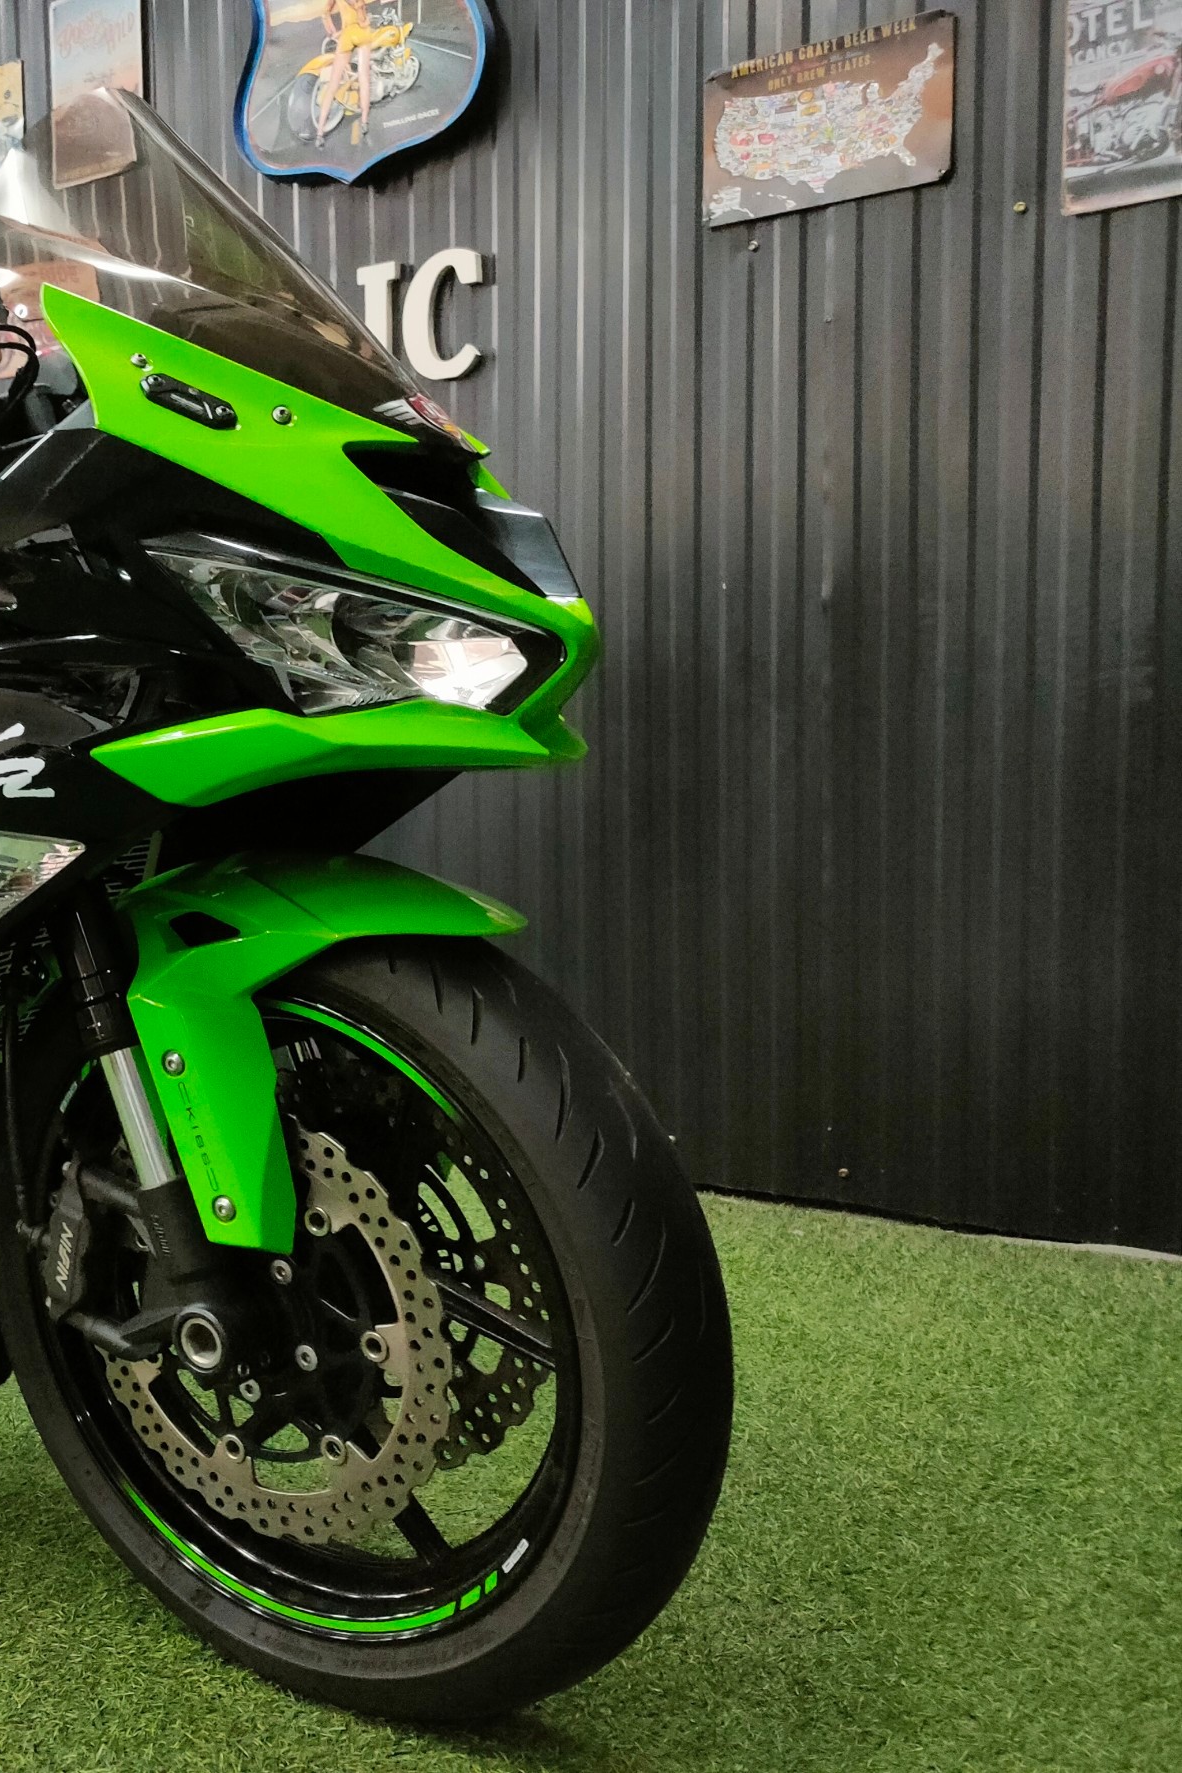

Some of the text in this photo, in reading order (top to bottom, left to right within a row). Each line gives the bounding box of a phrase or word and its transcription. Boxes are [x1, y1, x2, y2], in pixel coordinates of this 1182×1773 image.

[731, 51, 794, 79] AMERICAN
[798, 38, 837, 60] CRAFT
[844, 26, 875, 48] BEER
[880, 17, 917, 37] WEEK
